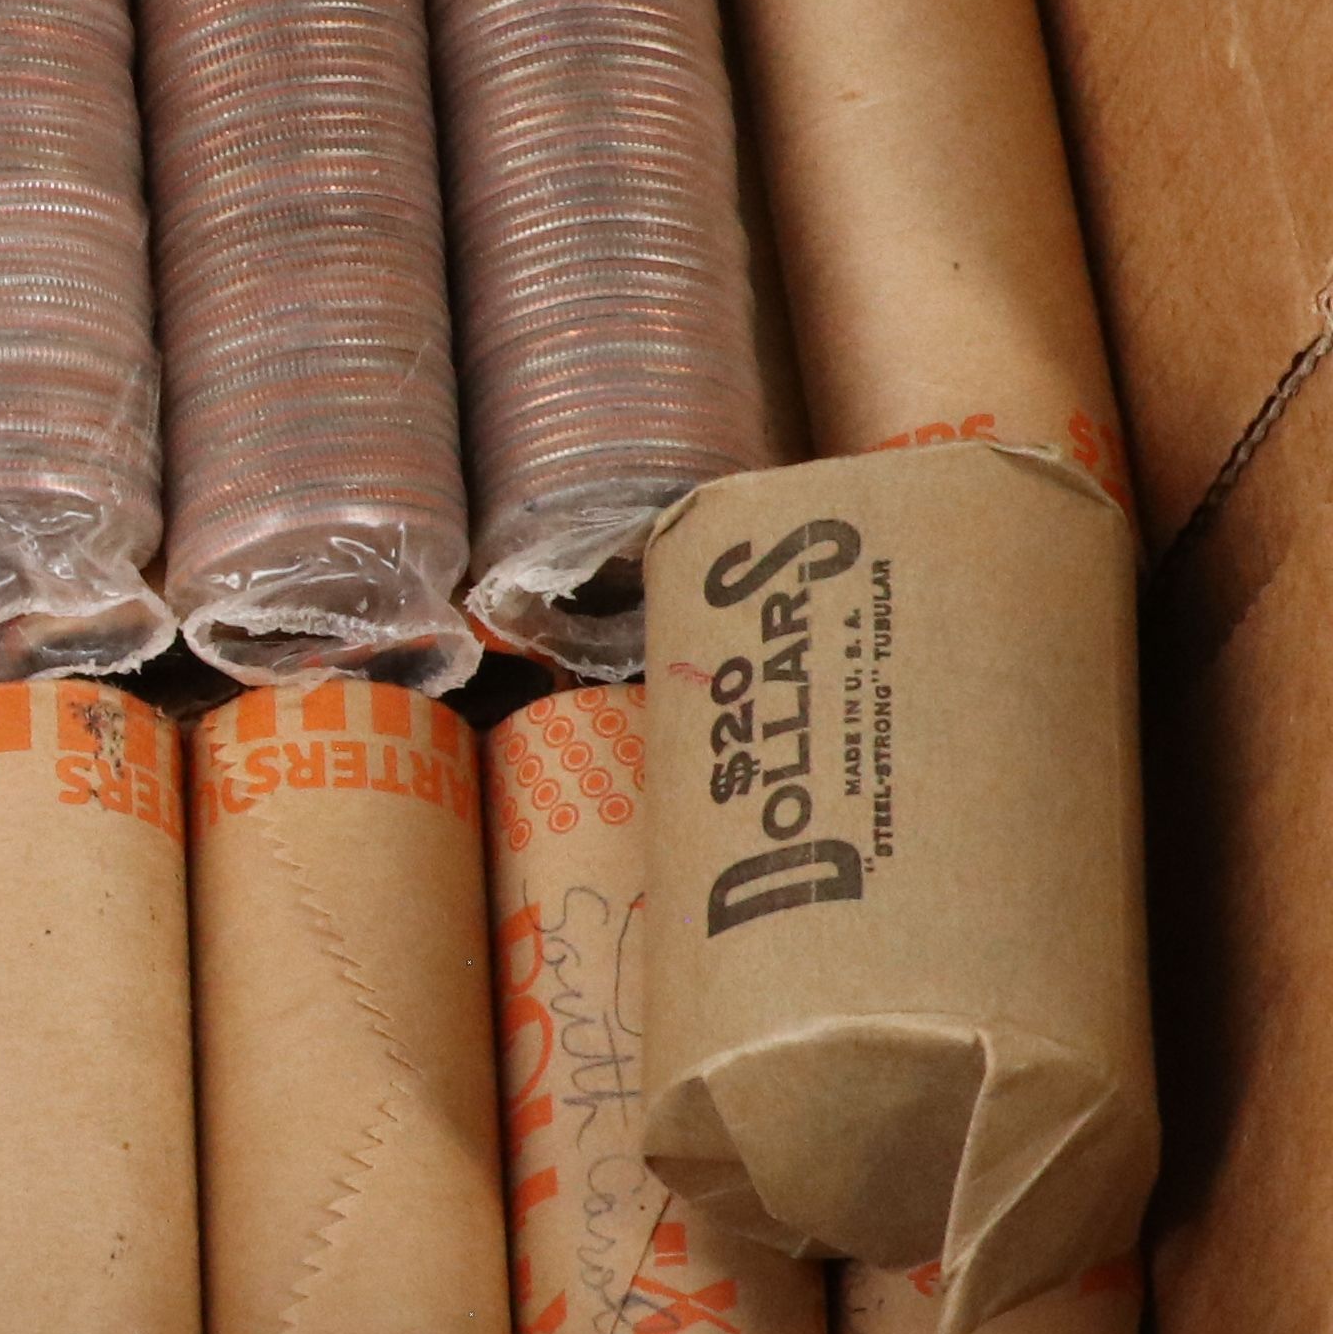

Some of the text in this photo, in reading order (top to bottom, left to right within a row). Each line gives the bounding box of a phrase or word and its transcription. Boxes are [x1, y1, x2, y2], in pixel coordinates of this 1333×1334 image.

[871, 558, 894, 663] TUBULAR
[703, 518, 863, 939] DOLLARS
[709, 655, 761, 805] $20
[843, 698, 863, 725] IN
[843, 731, 863, 797] MADE
